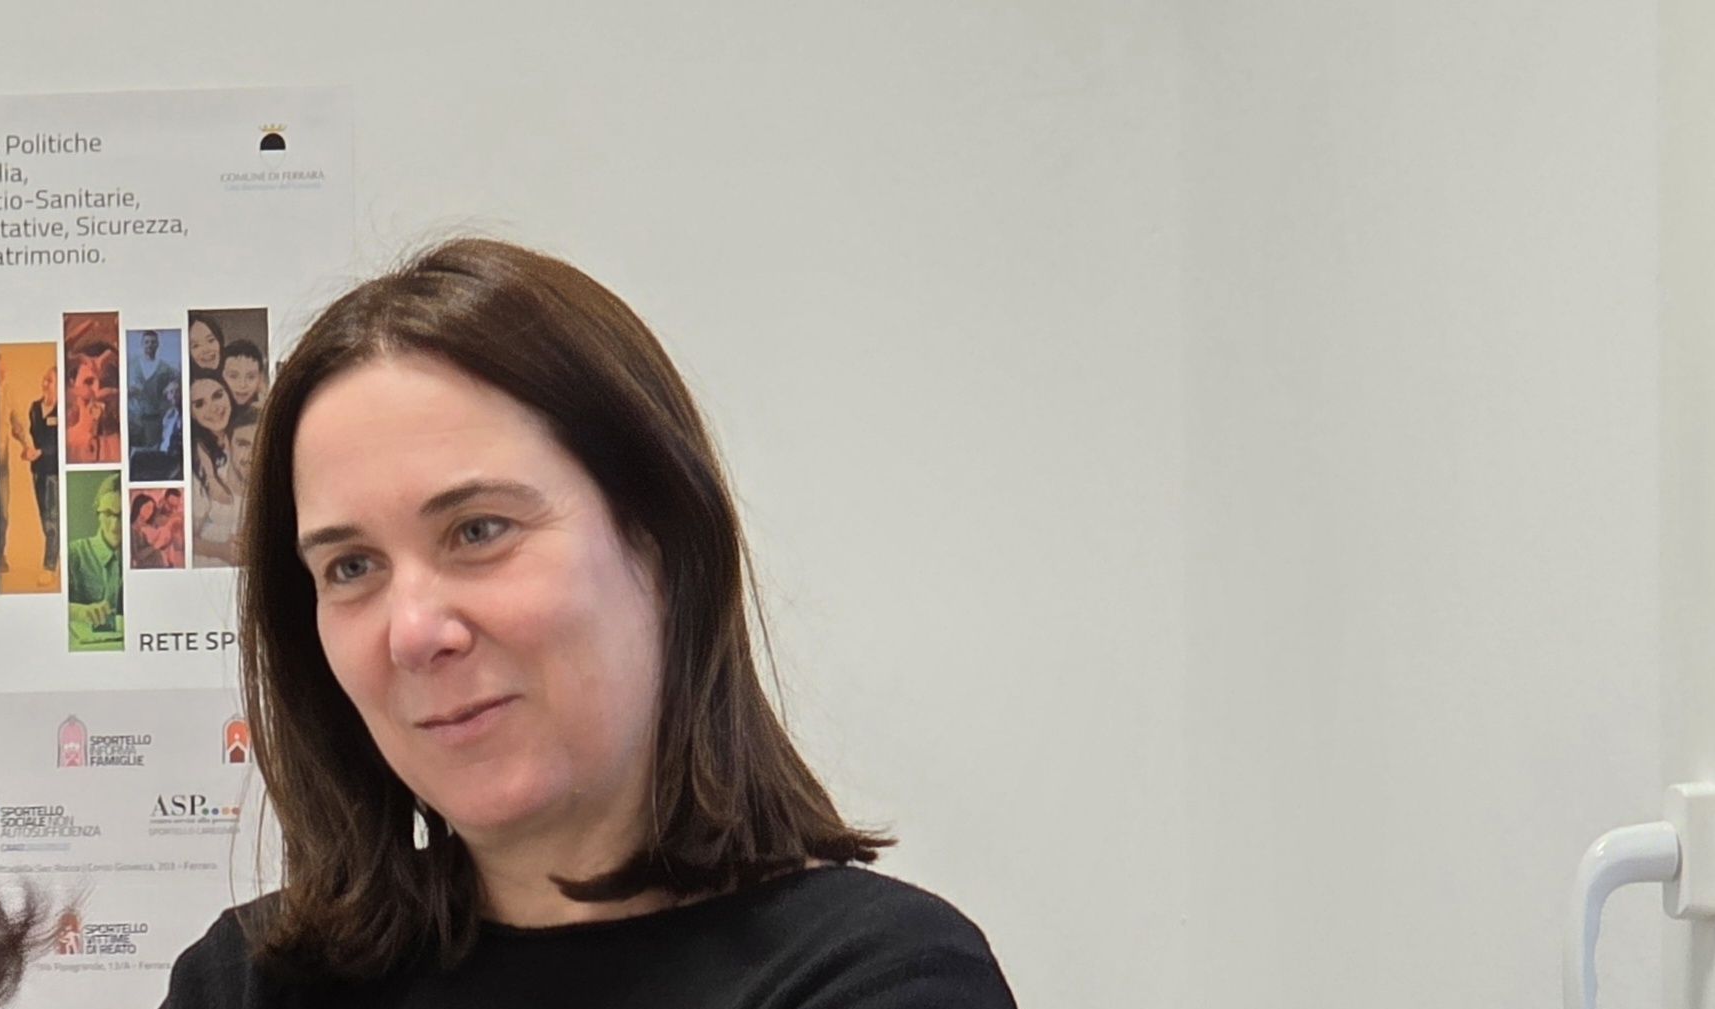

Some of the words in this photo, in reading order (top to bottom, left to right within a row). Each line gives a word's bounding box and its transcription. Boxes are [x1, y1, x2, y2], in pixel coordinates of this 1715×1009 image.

[5, 133, 102, 156] Politiche
[75, 214, 189, 238] Sicurezza,
[139, 633, 199, 651] RETE
[206, 631, 235, 650] SP
[89, 734, 151, 746] SPORTELLO
[89, 755, 145, 767] FAMIGLIE
[0, 806, 64, 817] SPORTELLO
[0, 817, 46, 828] SOCIALE
[84, 923, 148, 935] SPORTELLO
[100, 944, 137, 955] REATO
